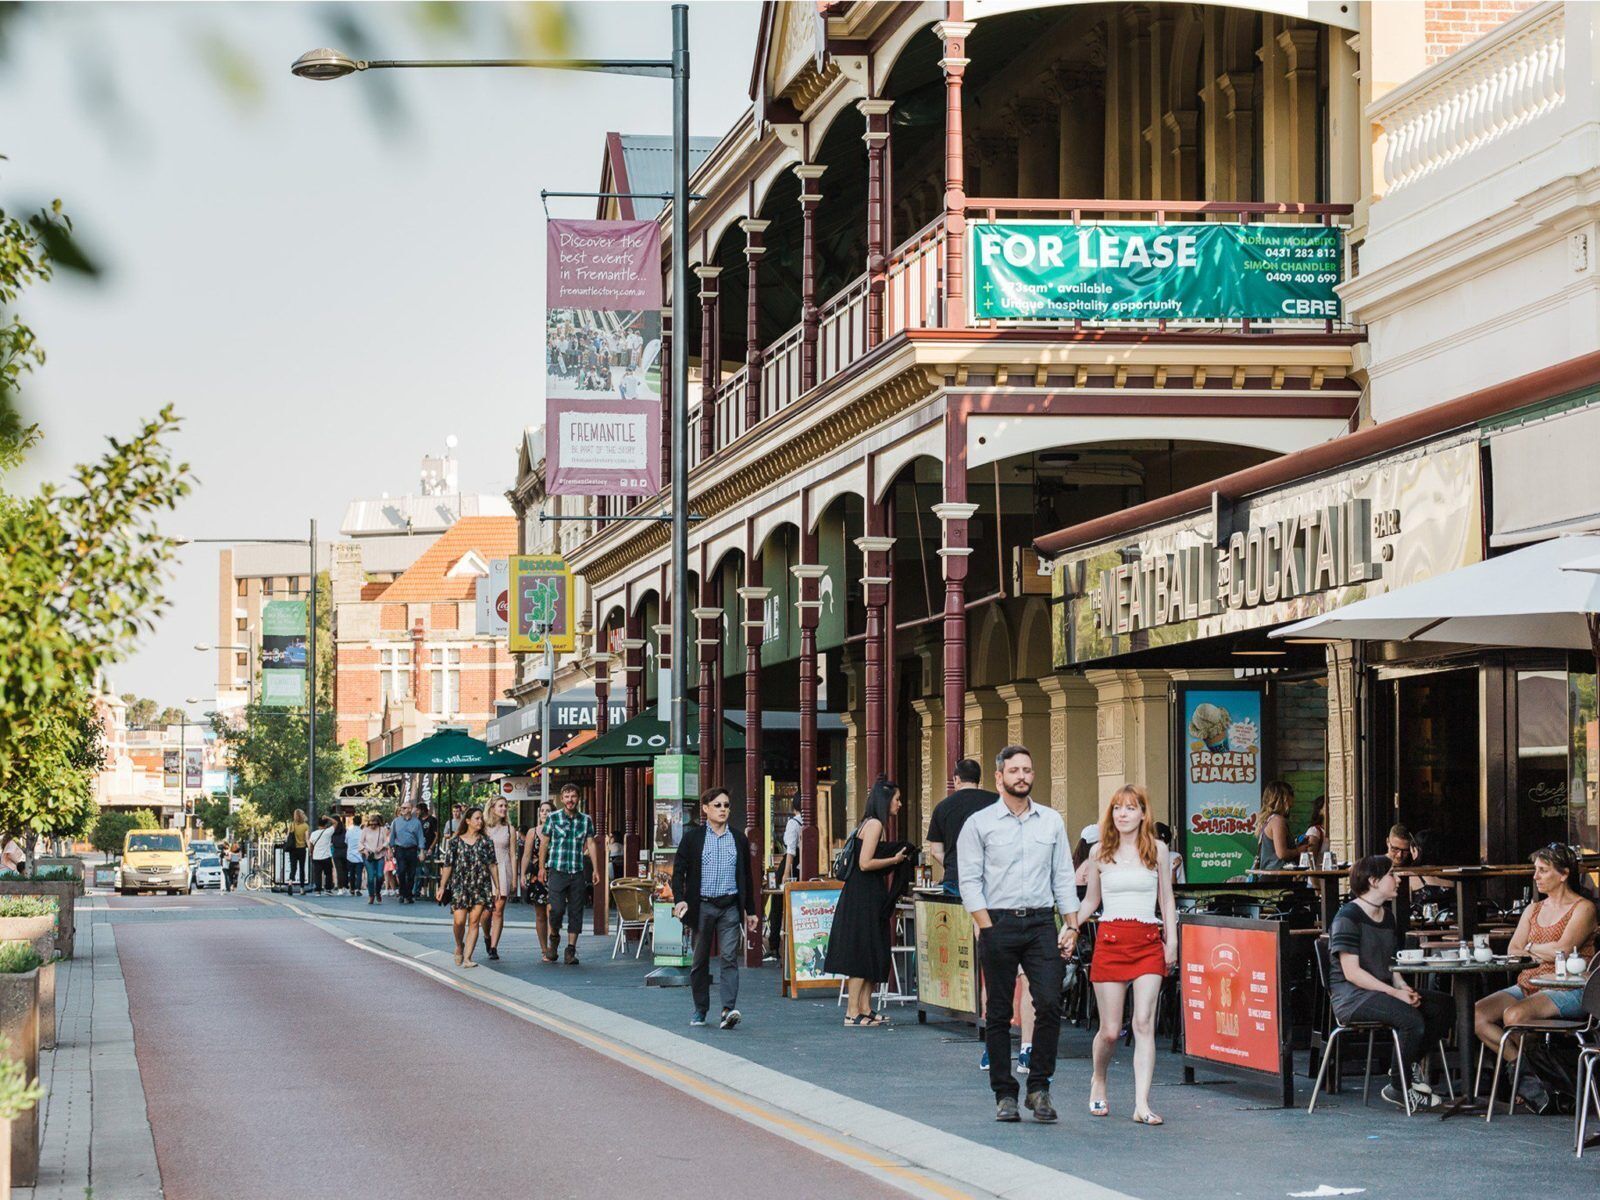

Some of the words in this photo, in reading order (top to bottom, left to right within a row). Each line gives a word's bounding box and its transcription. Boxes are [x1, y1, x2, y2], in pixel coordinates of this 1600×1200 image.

[559, 233, 615, 247] Discover
[622, 235, 644, 247] the
[1241, 237, 1280, 246] ADRIAN
[559, 251, 587, 264] best
[592, 253, 635, 266] events
[981, 234, 1064, 268] FOR
[1078, 235, 1197, 269] LEASE
[1265, 248, 1290, 257] 0431
[1294, 248, 1314, 257] 282
[1317, 248, 1336, 257] 812
[1243, 260, 1278, 270] SIMON
[1281, 262, 1337, 271] CHANDLER
[560, 267, 570, 280] in
[1266, 272, 1292, 282] 0409
[1294, 273, 1314, 283] 400
[1317, 274, 1337, 283] 699
[1057, 282, 1113, 295] available
[1047, 299, 1110, 312] hospitality
[1112, 298, 1182, 313] opportunity
[1281, 299, 1337, 316] CBRE
[570, 422, 636, 442] FREMANTLE
[1088, 588, 1102, 610] THE
[1100, 543, 1217, 638] MEATBALL
[1228, 499, 1376, 610] COCKTAIL
[1190, 751, 1255, 768] FROZEN
[1191, 766, 1256, 783] FLAKES
[1201, 859, 1232, 868] good!
